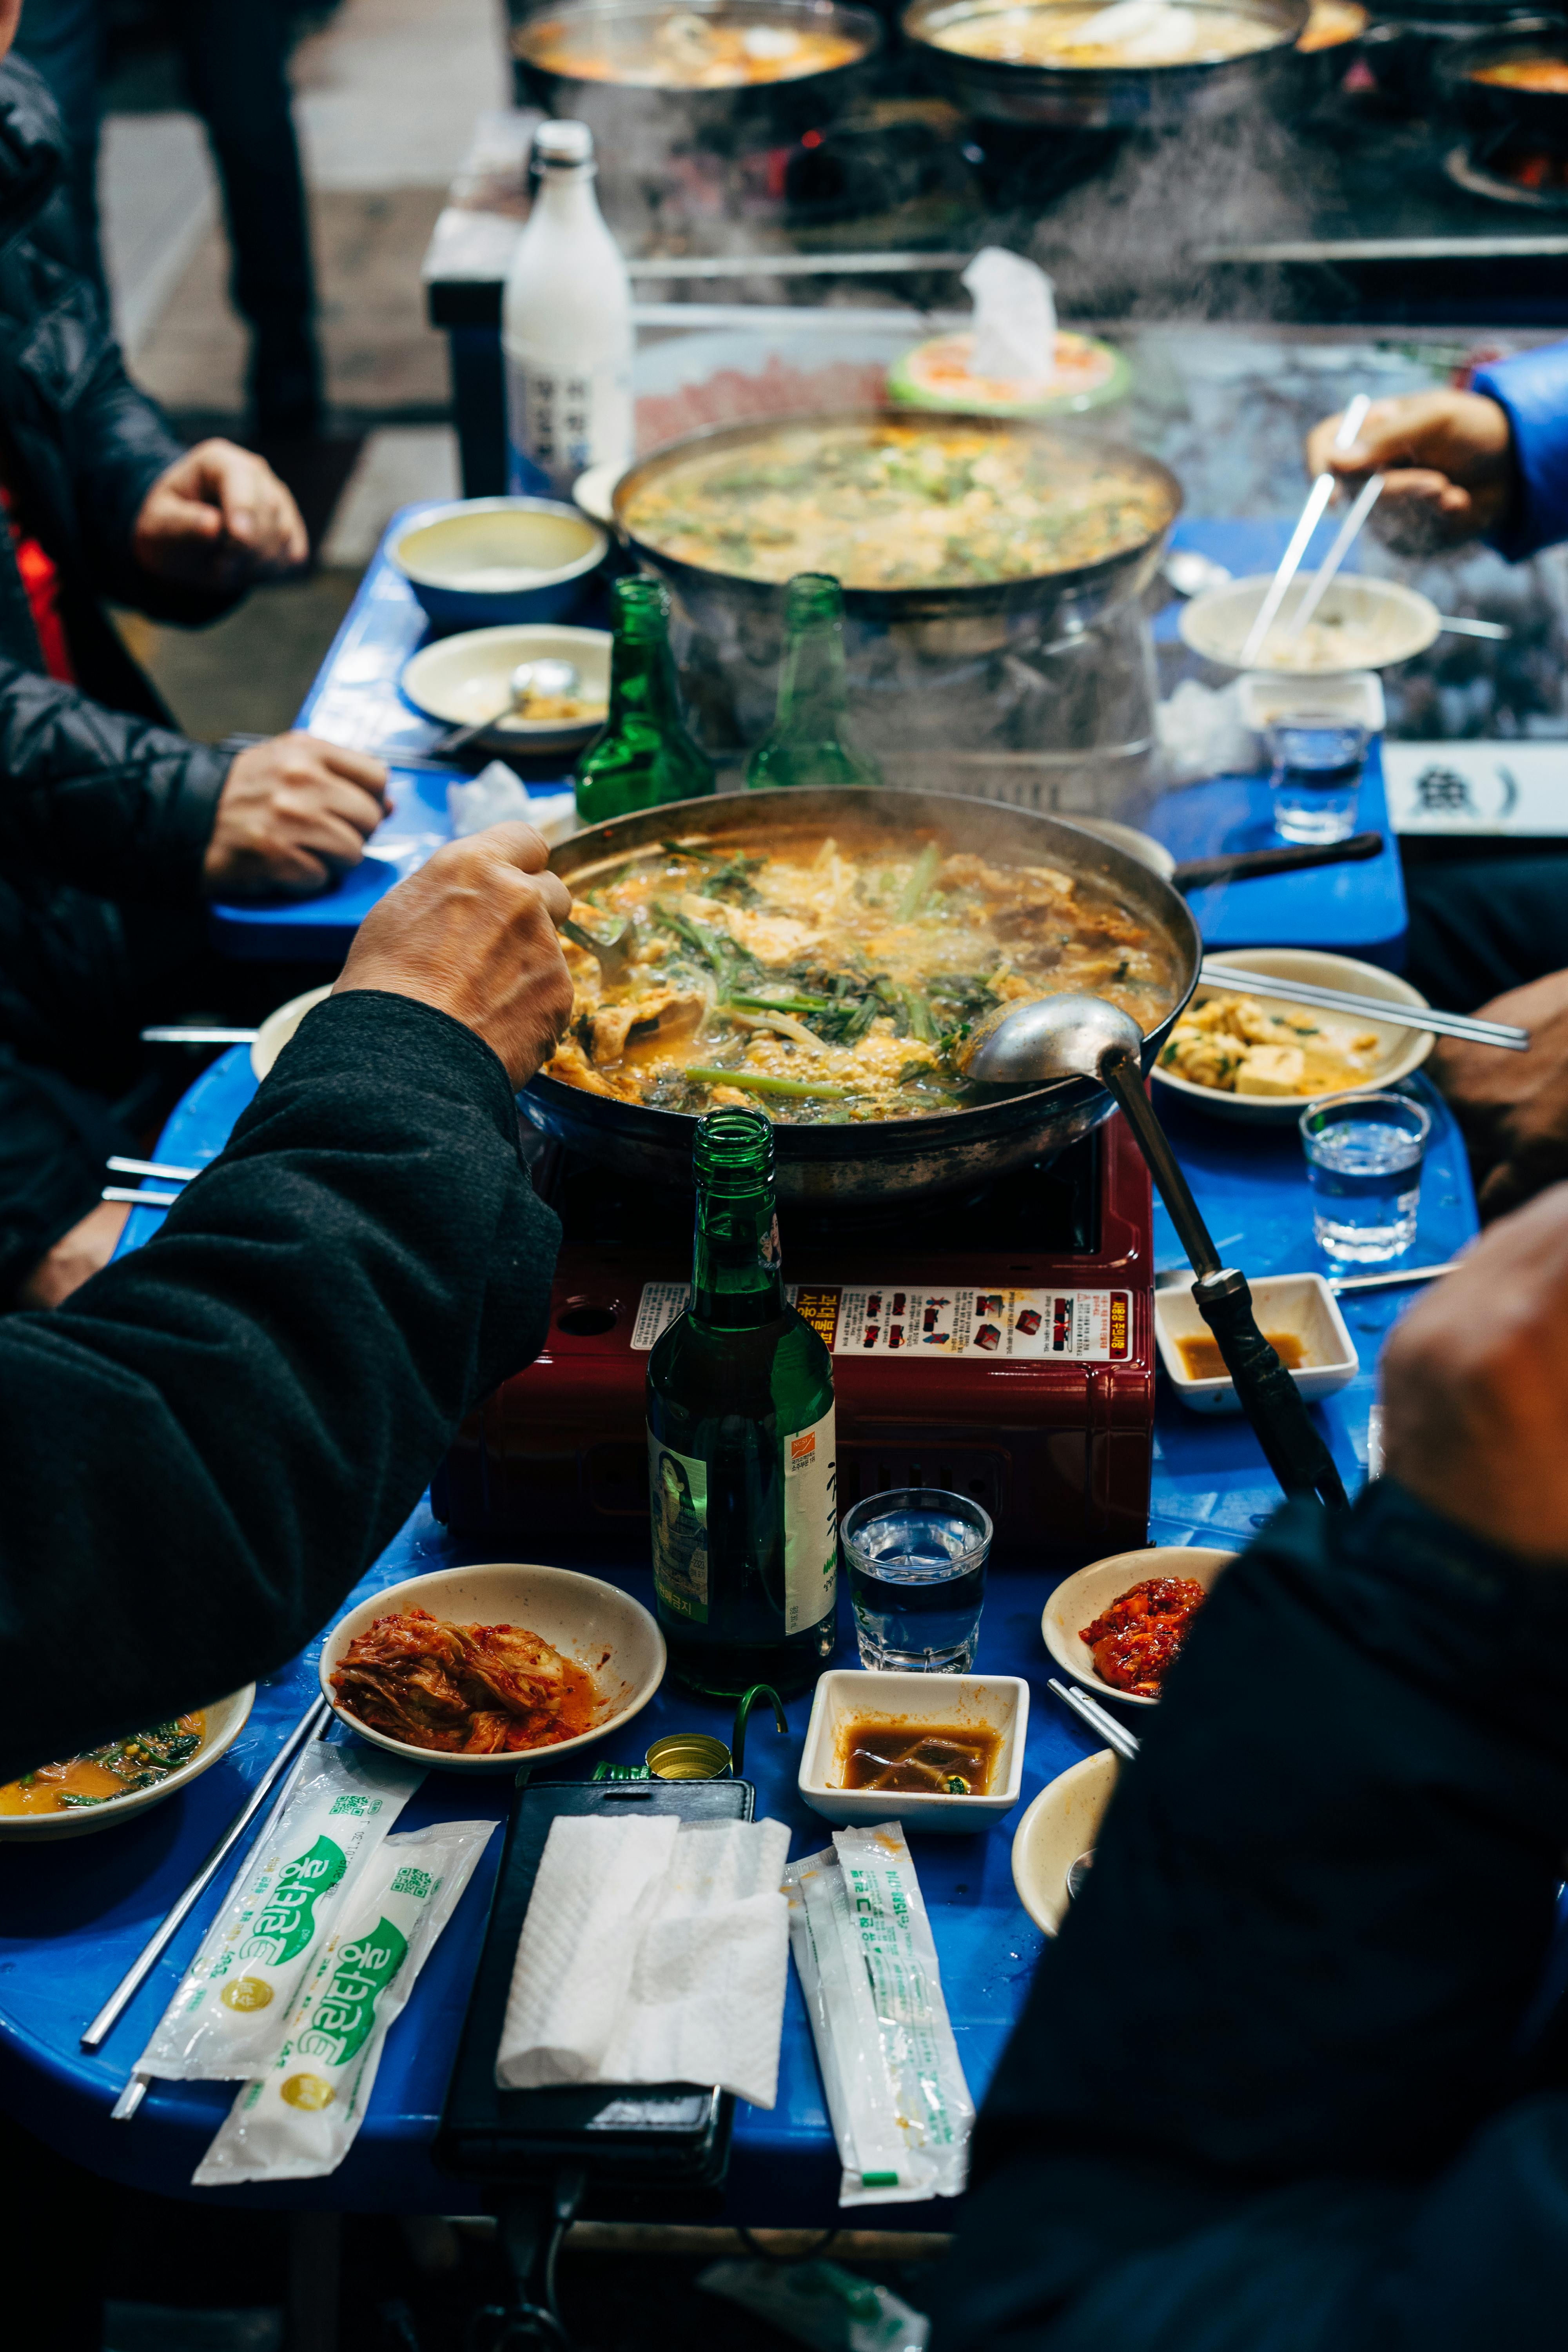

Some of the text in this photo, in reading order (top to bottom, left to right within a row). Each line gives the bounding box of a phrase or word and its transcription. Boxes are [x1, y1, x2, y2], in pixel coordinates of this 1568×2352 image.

[797, 1293, 818, 1318] 사용
[1111, 1301, 1125, 1349] 사용상 주의사항
[791, 1455, 815, 1471] 소주부문 1위
[793, 1438, 808, 1448] NCSI
[659, 1582, 691, 1615] 판매금지
[333, 1832, 365, 1880] 2019.01.30
[240, 1857, 329, 1965] 크린타올
[885, 1871, 907, 1915] 1588-1714
[298, 1941, 392, 2066] 크린타올
